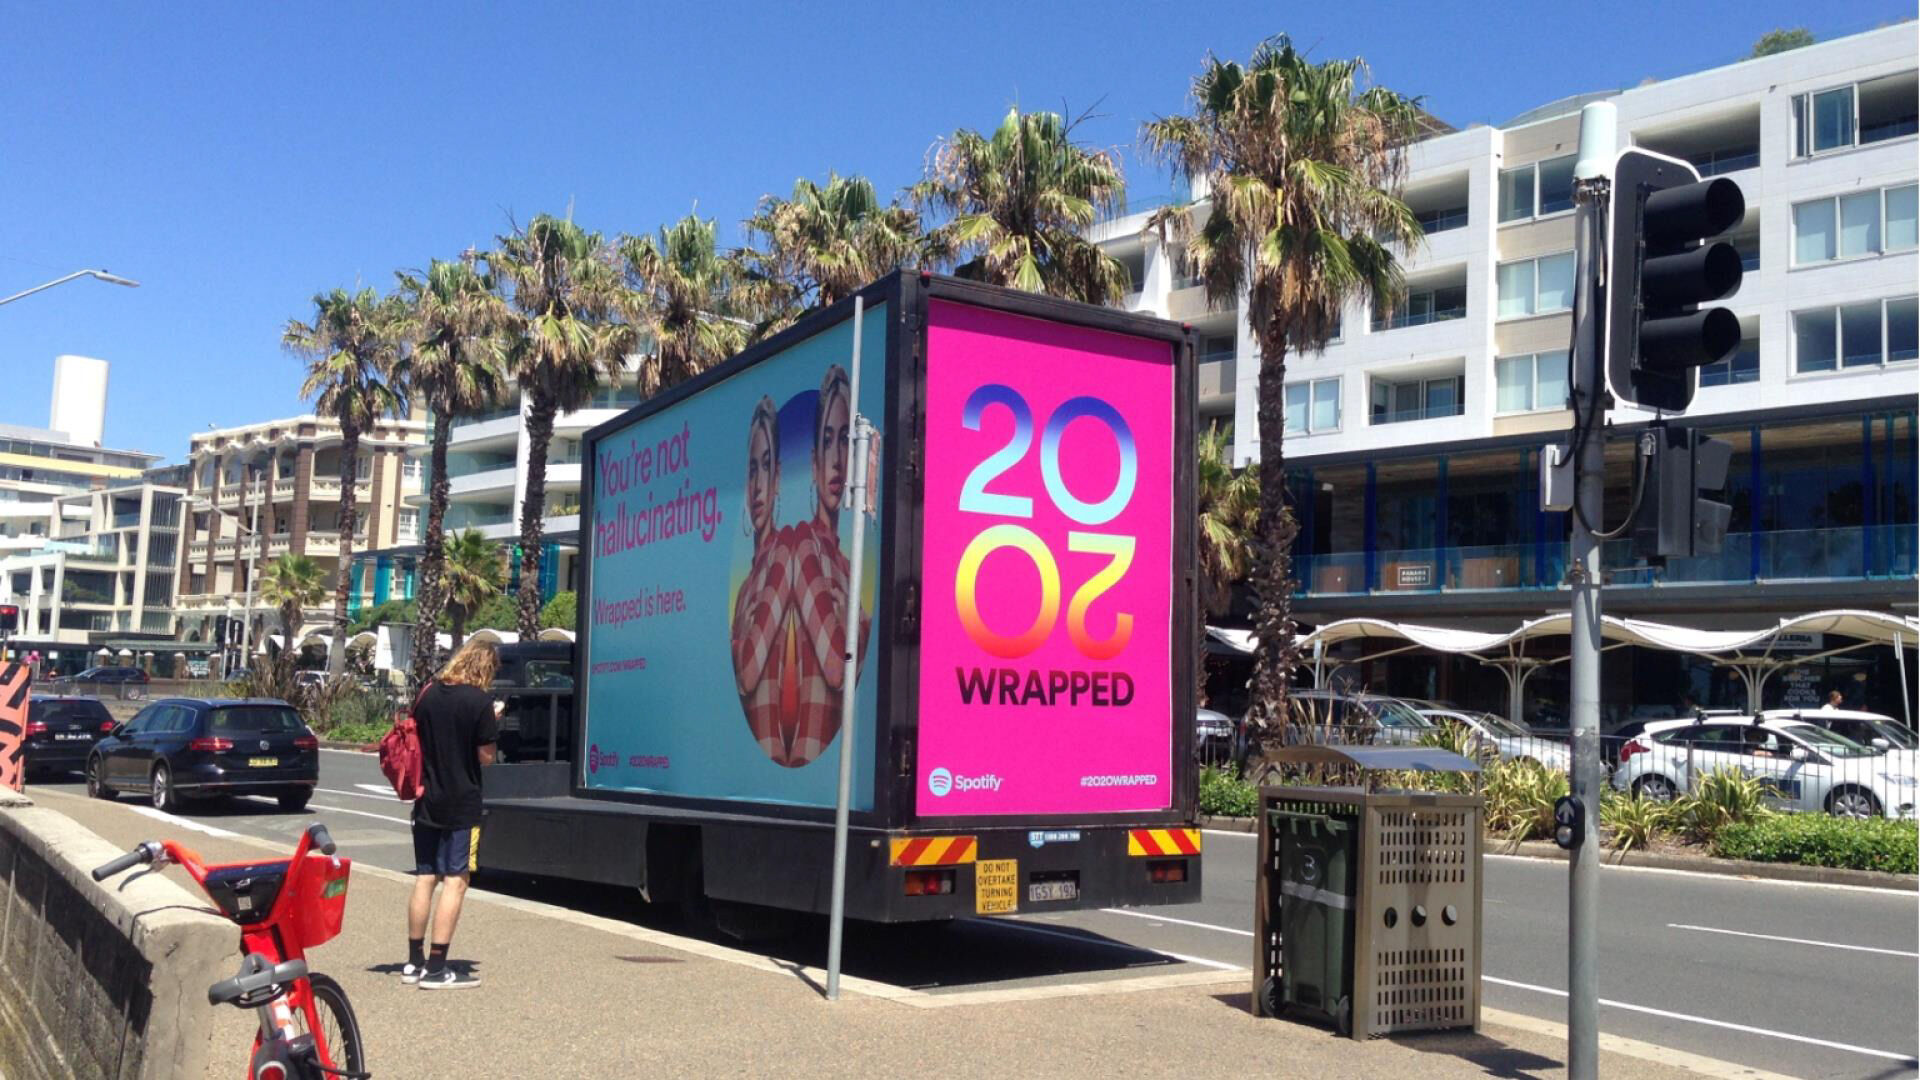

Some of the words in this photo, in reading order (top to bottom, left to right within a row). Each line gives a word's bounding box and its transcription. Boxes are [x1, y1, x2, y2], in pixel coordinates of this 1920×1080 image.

[599, 439, 652, 498] You're
[656, 420, 690, 478] not
[959, 383, 1138, 526] 20
[595, 477, 723, 559] hallucinating.
[594, 588, 643, 630] Wrapped
[644, 587, 654, 617] is
[655, 584, 687, 615] here.
[955, 666, 1135, 707] WRAPPED
[955, 774, 1002, 792] Spotify
[1080, 774, 1157, 787] #2020WRAPPED
[983, 864, 993, 873] DO
[995, 863, 1010, 873] NOT
[978, 875, 1015, 885] OVERTAKE
[982, 888, 1013, 898] TURNING
[983, 900, 1013, 911] VEHICLE
